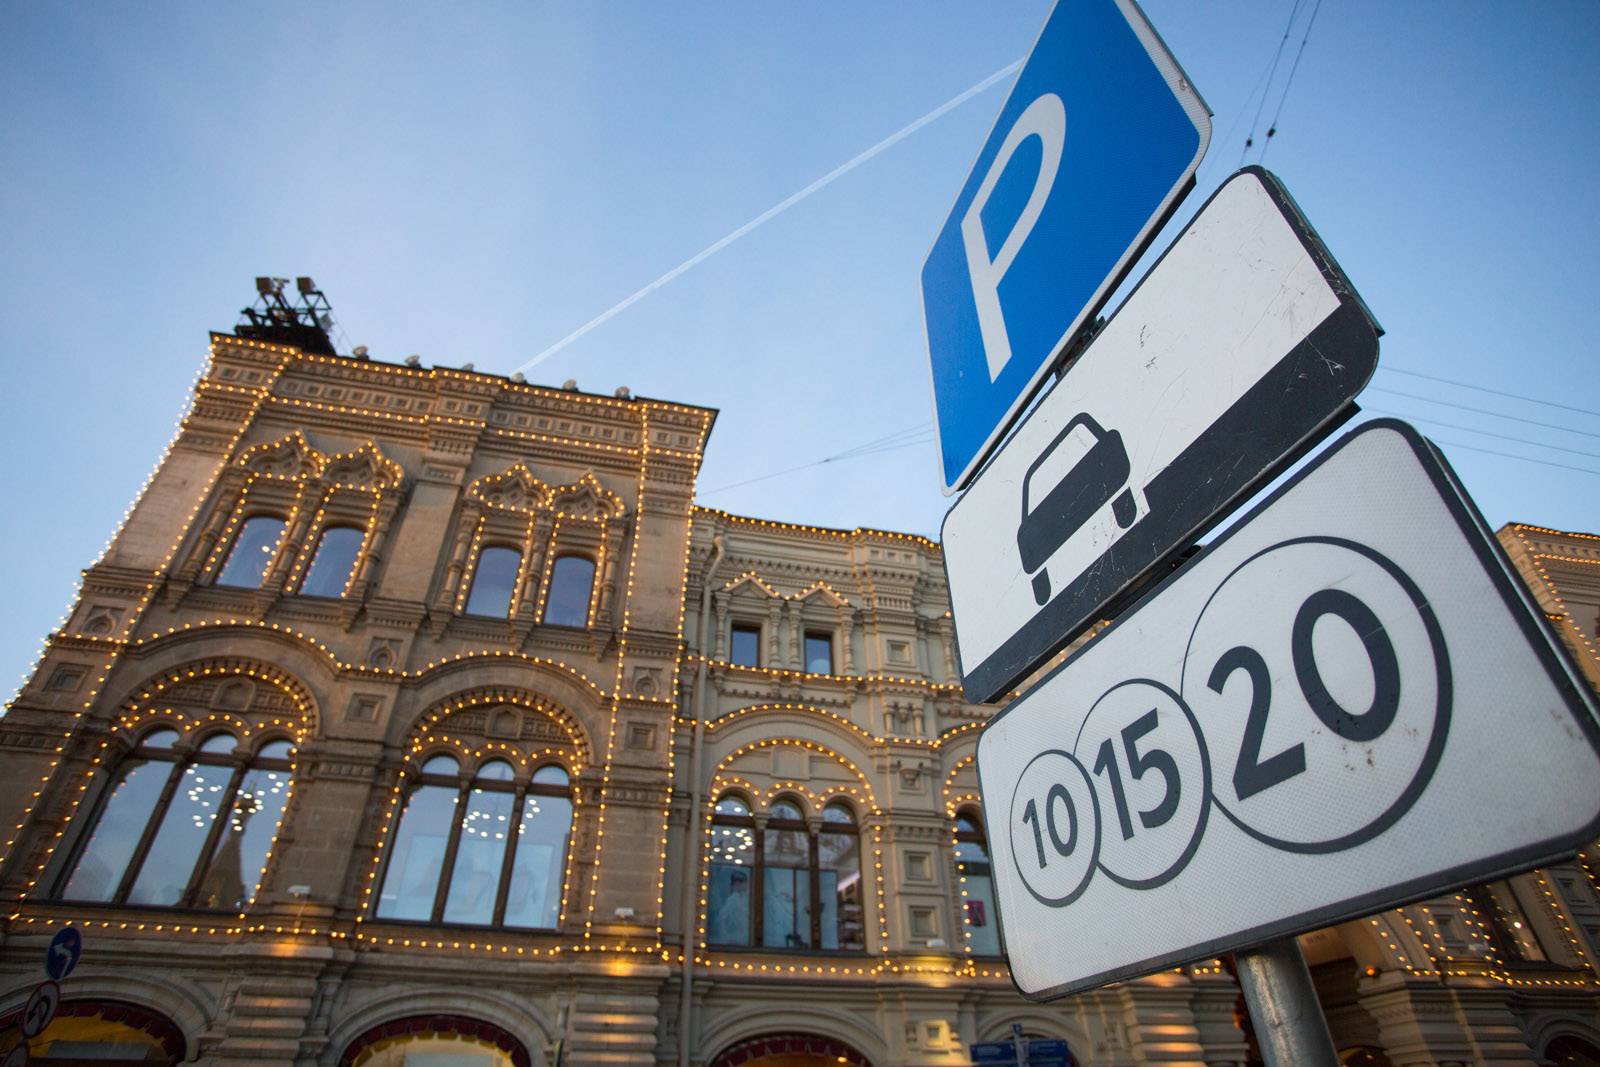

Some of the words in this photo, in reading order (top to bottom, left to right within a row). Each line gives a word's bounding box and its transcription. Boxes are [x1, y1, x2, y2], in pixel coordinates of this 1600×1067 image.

[960, 92, 1066, 384] P
[1022, 783, 1078, 869] 10
[1092, 707, 1181, 841] 15
[1206, 588, 1401, 802] 20
